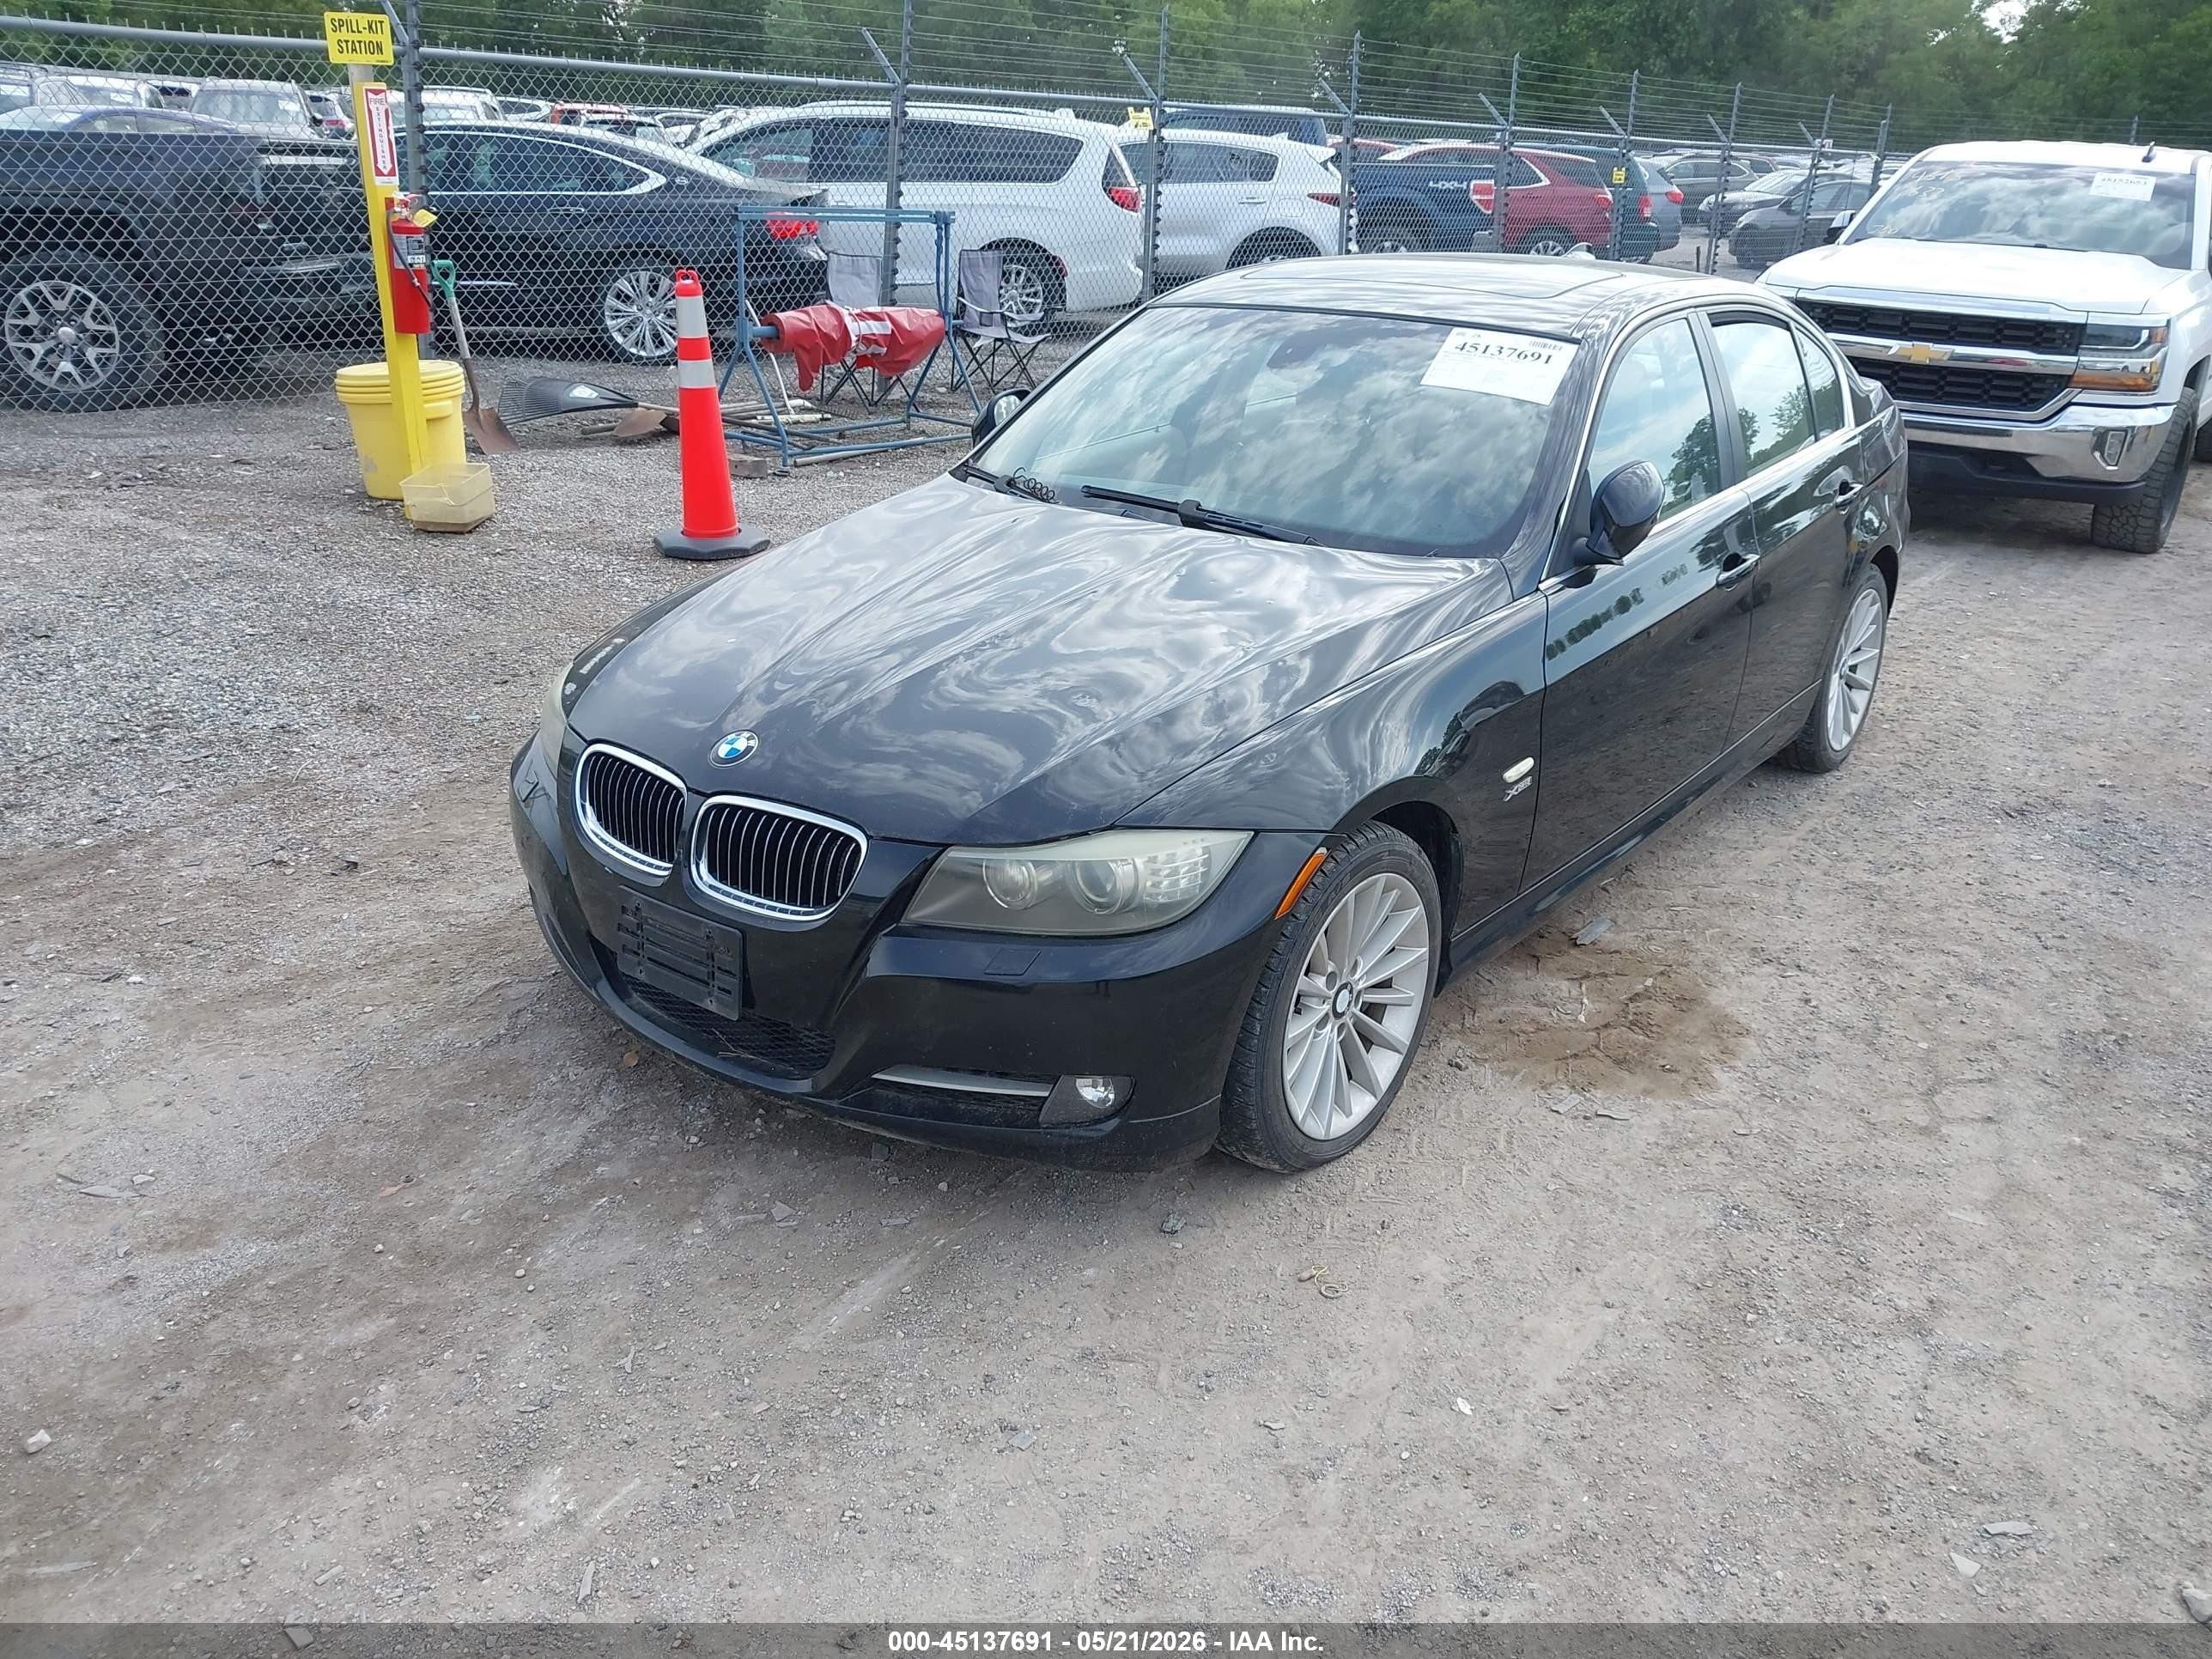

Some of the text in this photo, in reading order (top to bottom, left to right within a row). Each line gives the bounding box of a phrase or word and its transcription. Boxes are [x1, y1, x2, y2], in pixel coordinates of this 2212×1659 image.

[331, 17, 385, 34] SPILL-KIT
[337, 39, 384, 55] STATION
[369, 97, 386, 106] FIRE
[1455, 342, 1553, 364] 45137691
